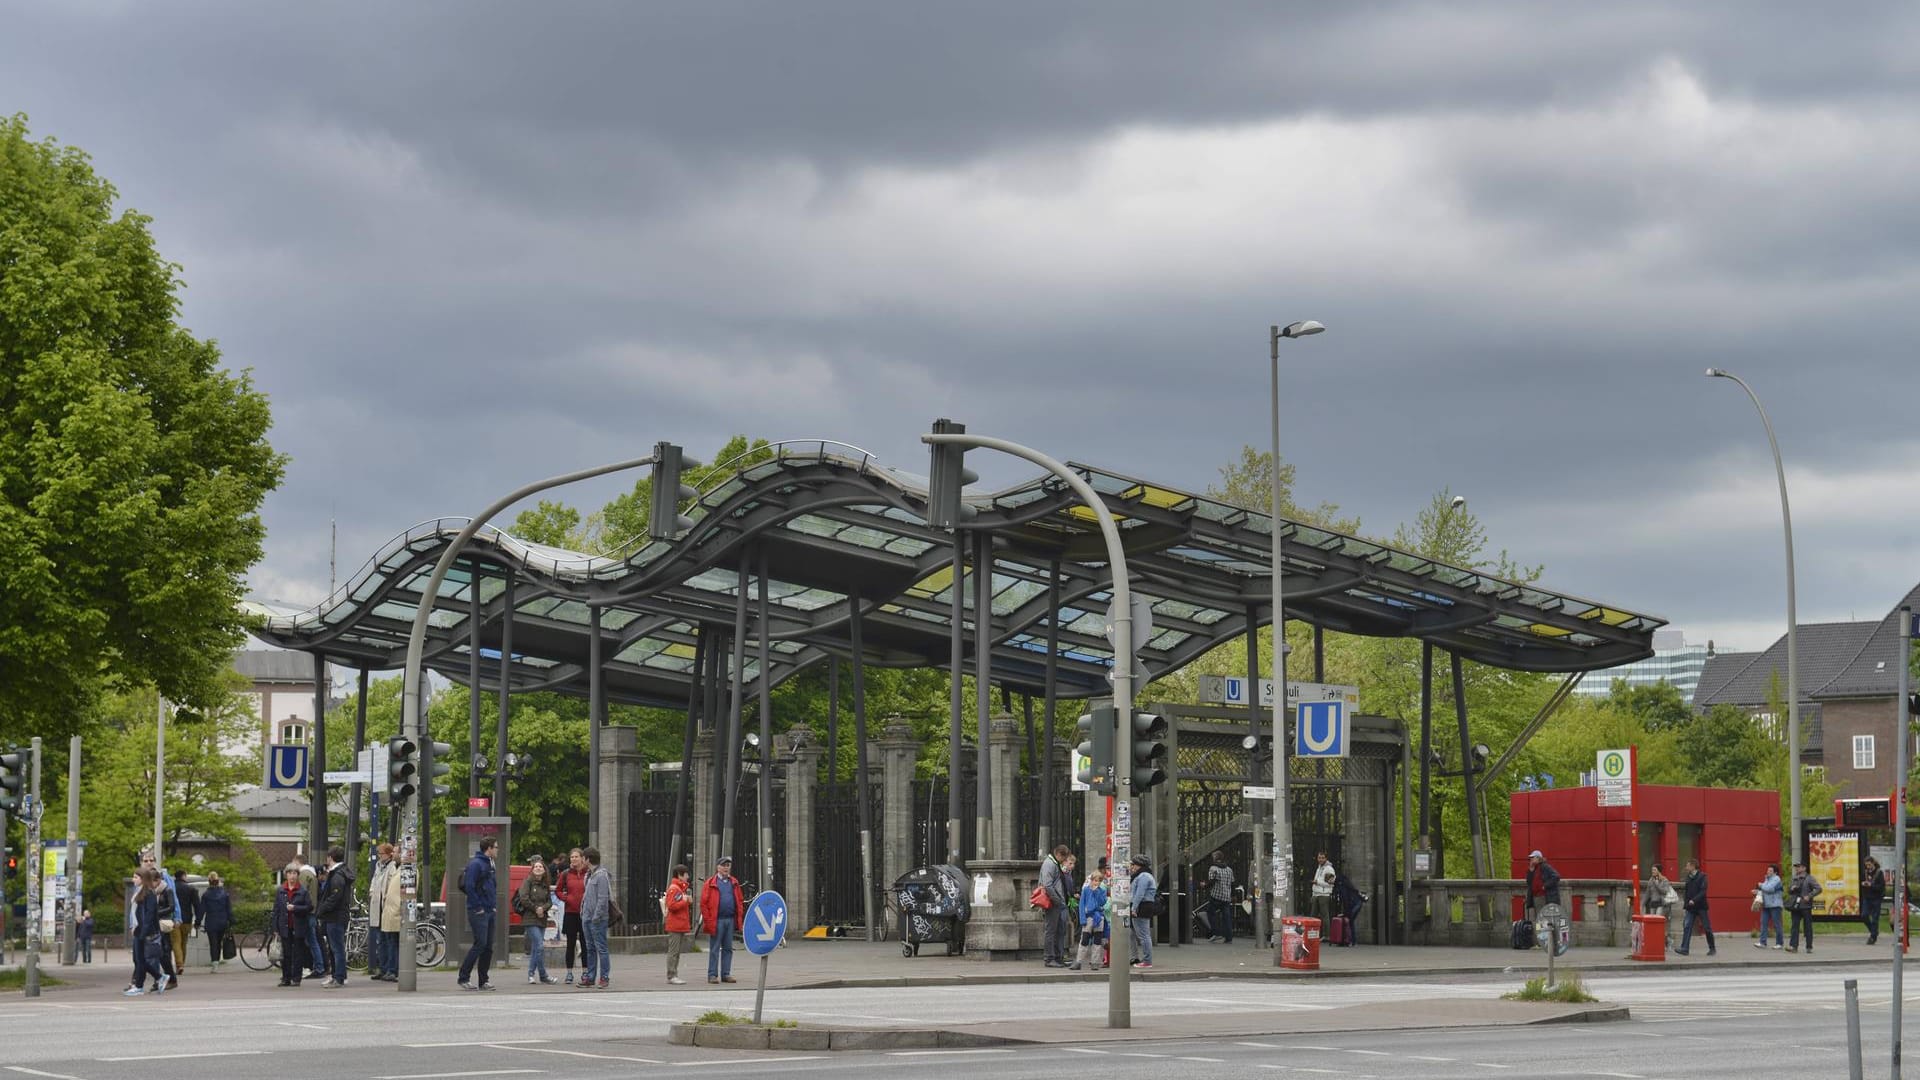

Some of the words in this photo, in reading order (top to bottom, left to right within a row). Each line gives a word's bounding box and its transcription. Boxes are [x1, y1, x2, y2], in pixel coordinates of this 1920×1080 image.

[1228, 681, 1239, 699] U
[1303, 705, 1336, 752] U
[275, 748, 304, 787] U
